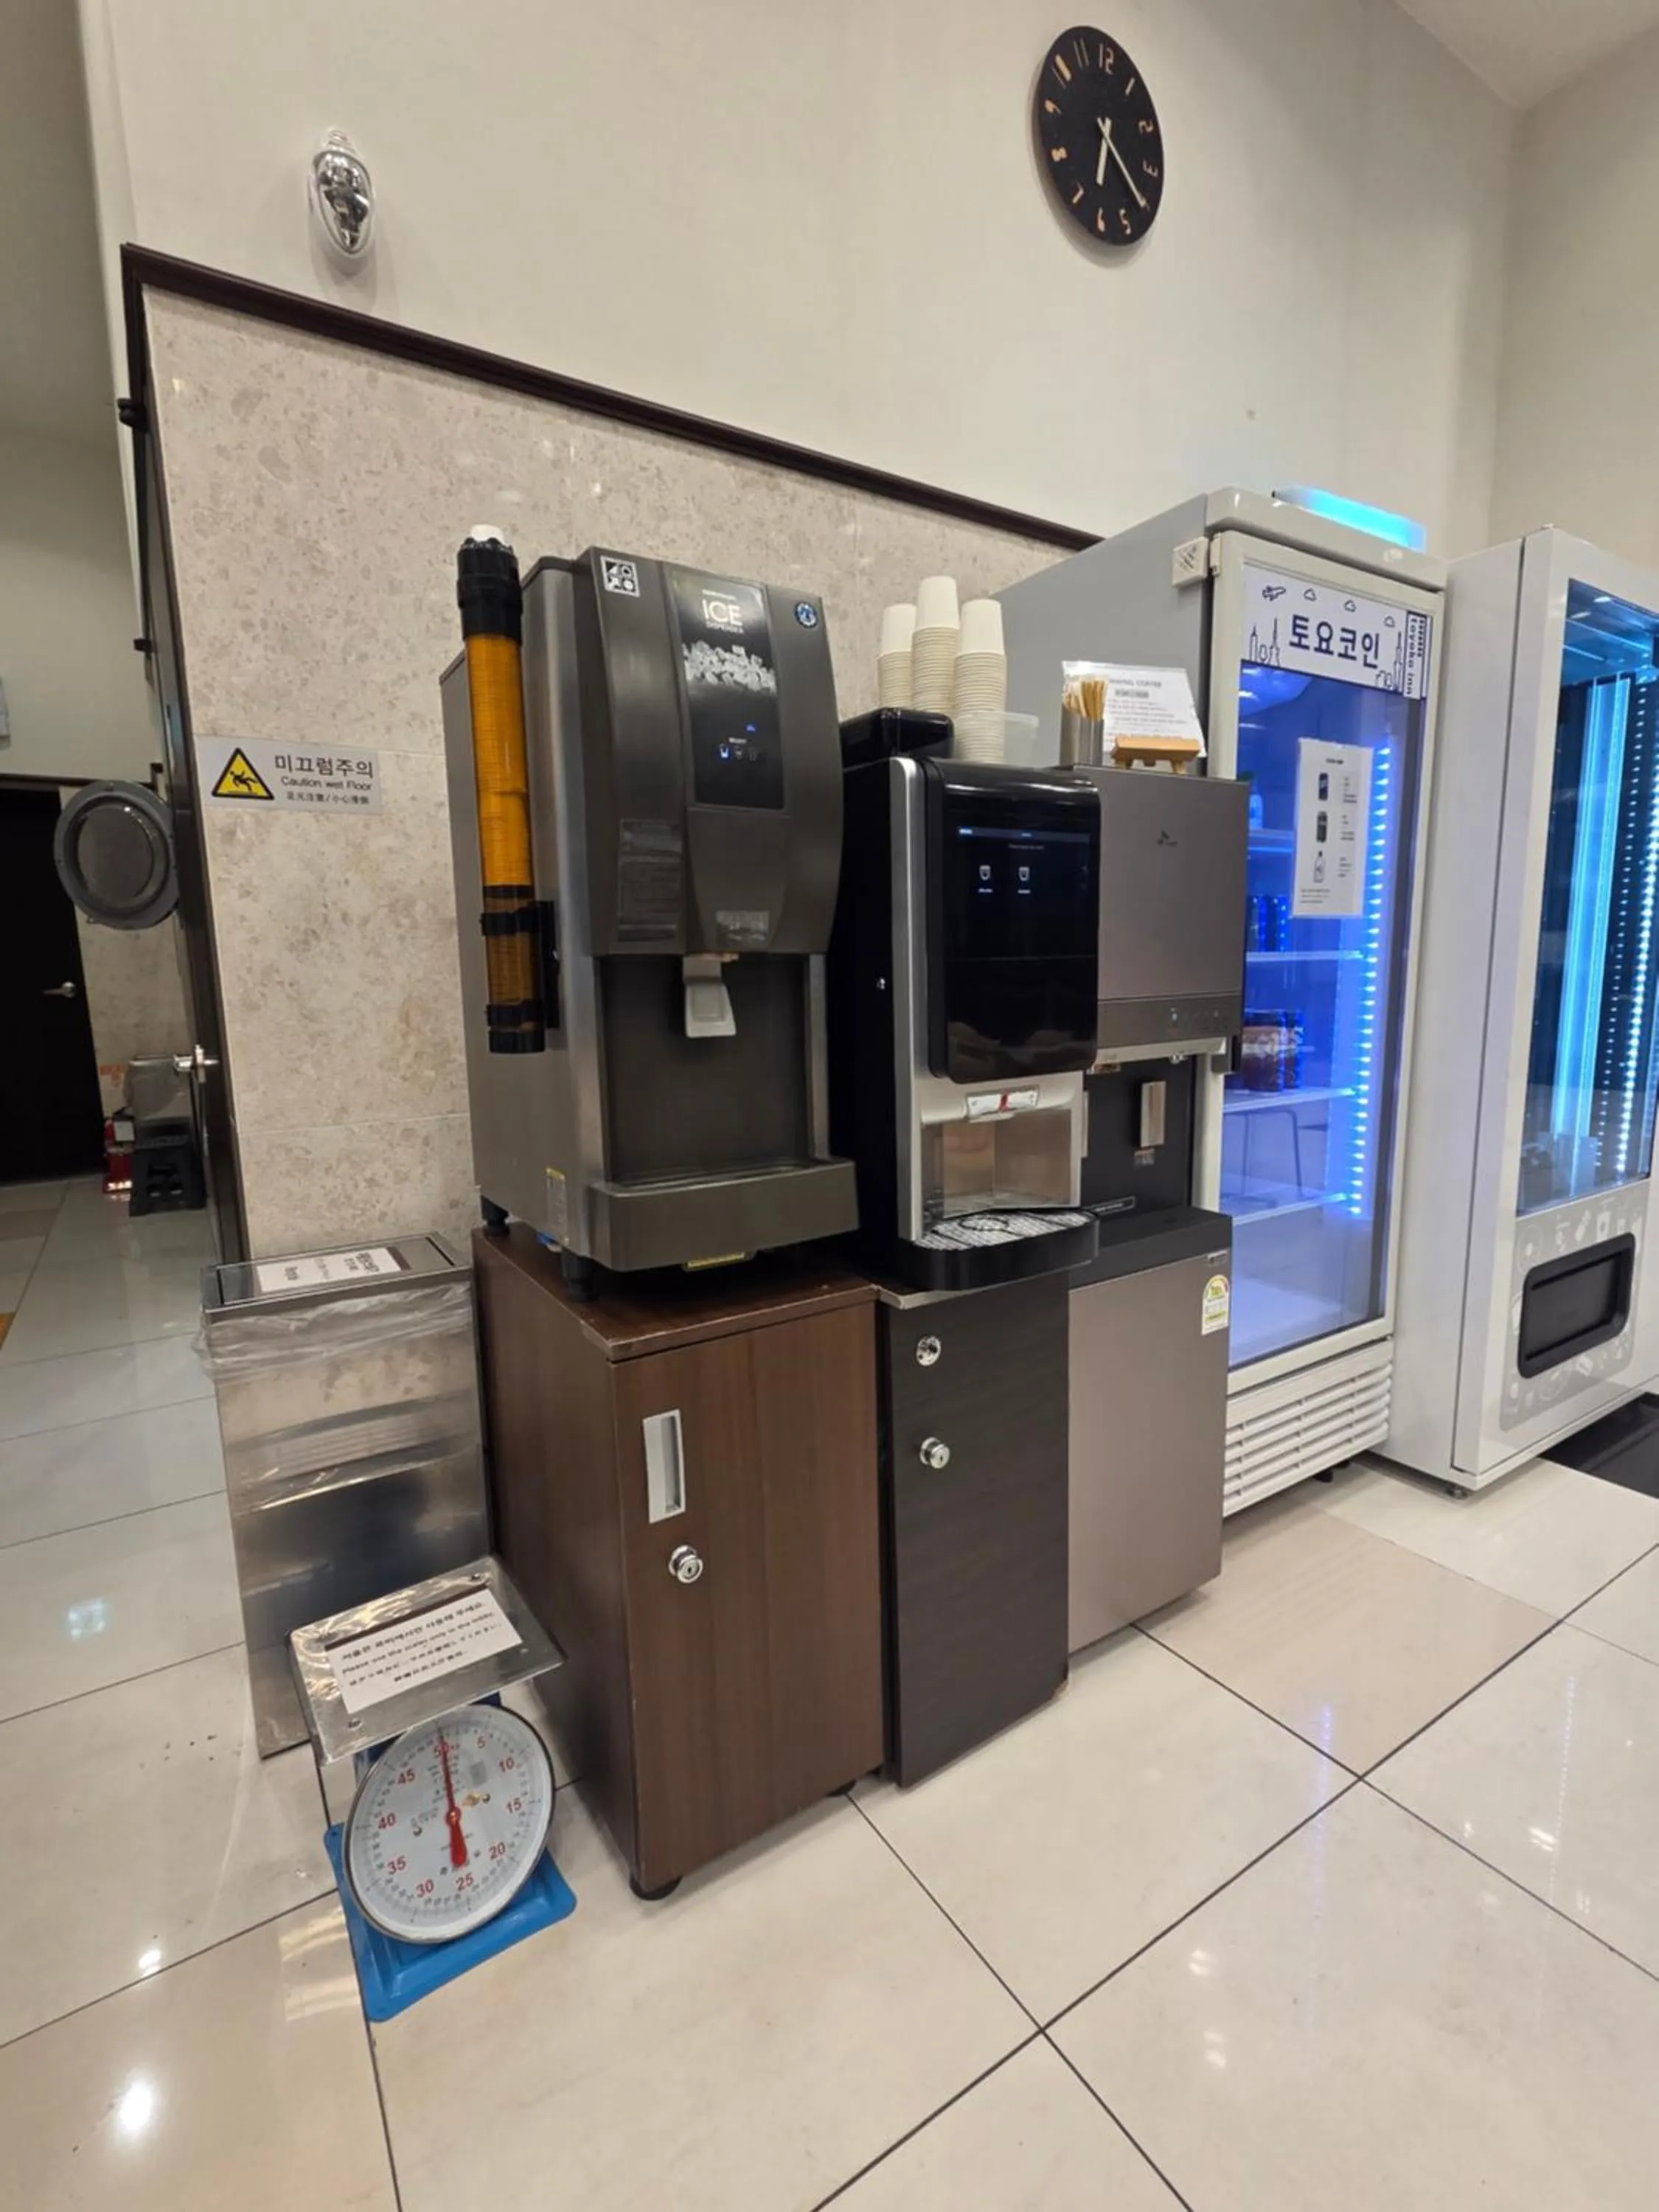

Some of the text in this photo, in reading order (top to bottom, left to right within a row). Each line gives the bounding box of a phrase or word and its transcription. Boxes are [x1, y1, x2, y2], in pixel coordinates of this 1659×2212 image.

[1099, 42, 1114, 74] 12
[1125, 77, 1135, 95] 1
[1138, 119, 1154, 133] 2
[1144, 160, 1158, 177] 3
[1118, 208, 1131, 235] 5
[702, 599, 742, 626] ICE
[1289, 614, 1380, 669] 토요코인
[275, 755, 373, 779] 미끄럼주의
[282, 776, 321, 787] Caution
[477, 1735, 486, 1749] 5
[499, 1756, 515, 1773] 10
[397, 1768, 416, 1785] 45
[507, 1797, 522, 1815] 15
[378, 1813, 396, 1831] 40
[488, 1841, 506, 1860] 20
[387, 1855, 406, 1876] 35
[416, 1879, 434, 1899] 30
[455, 1872, 473, 1892] 25
